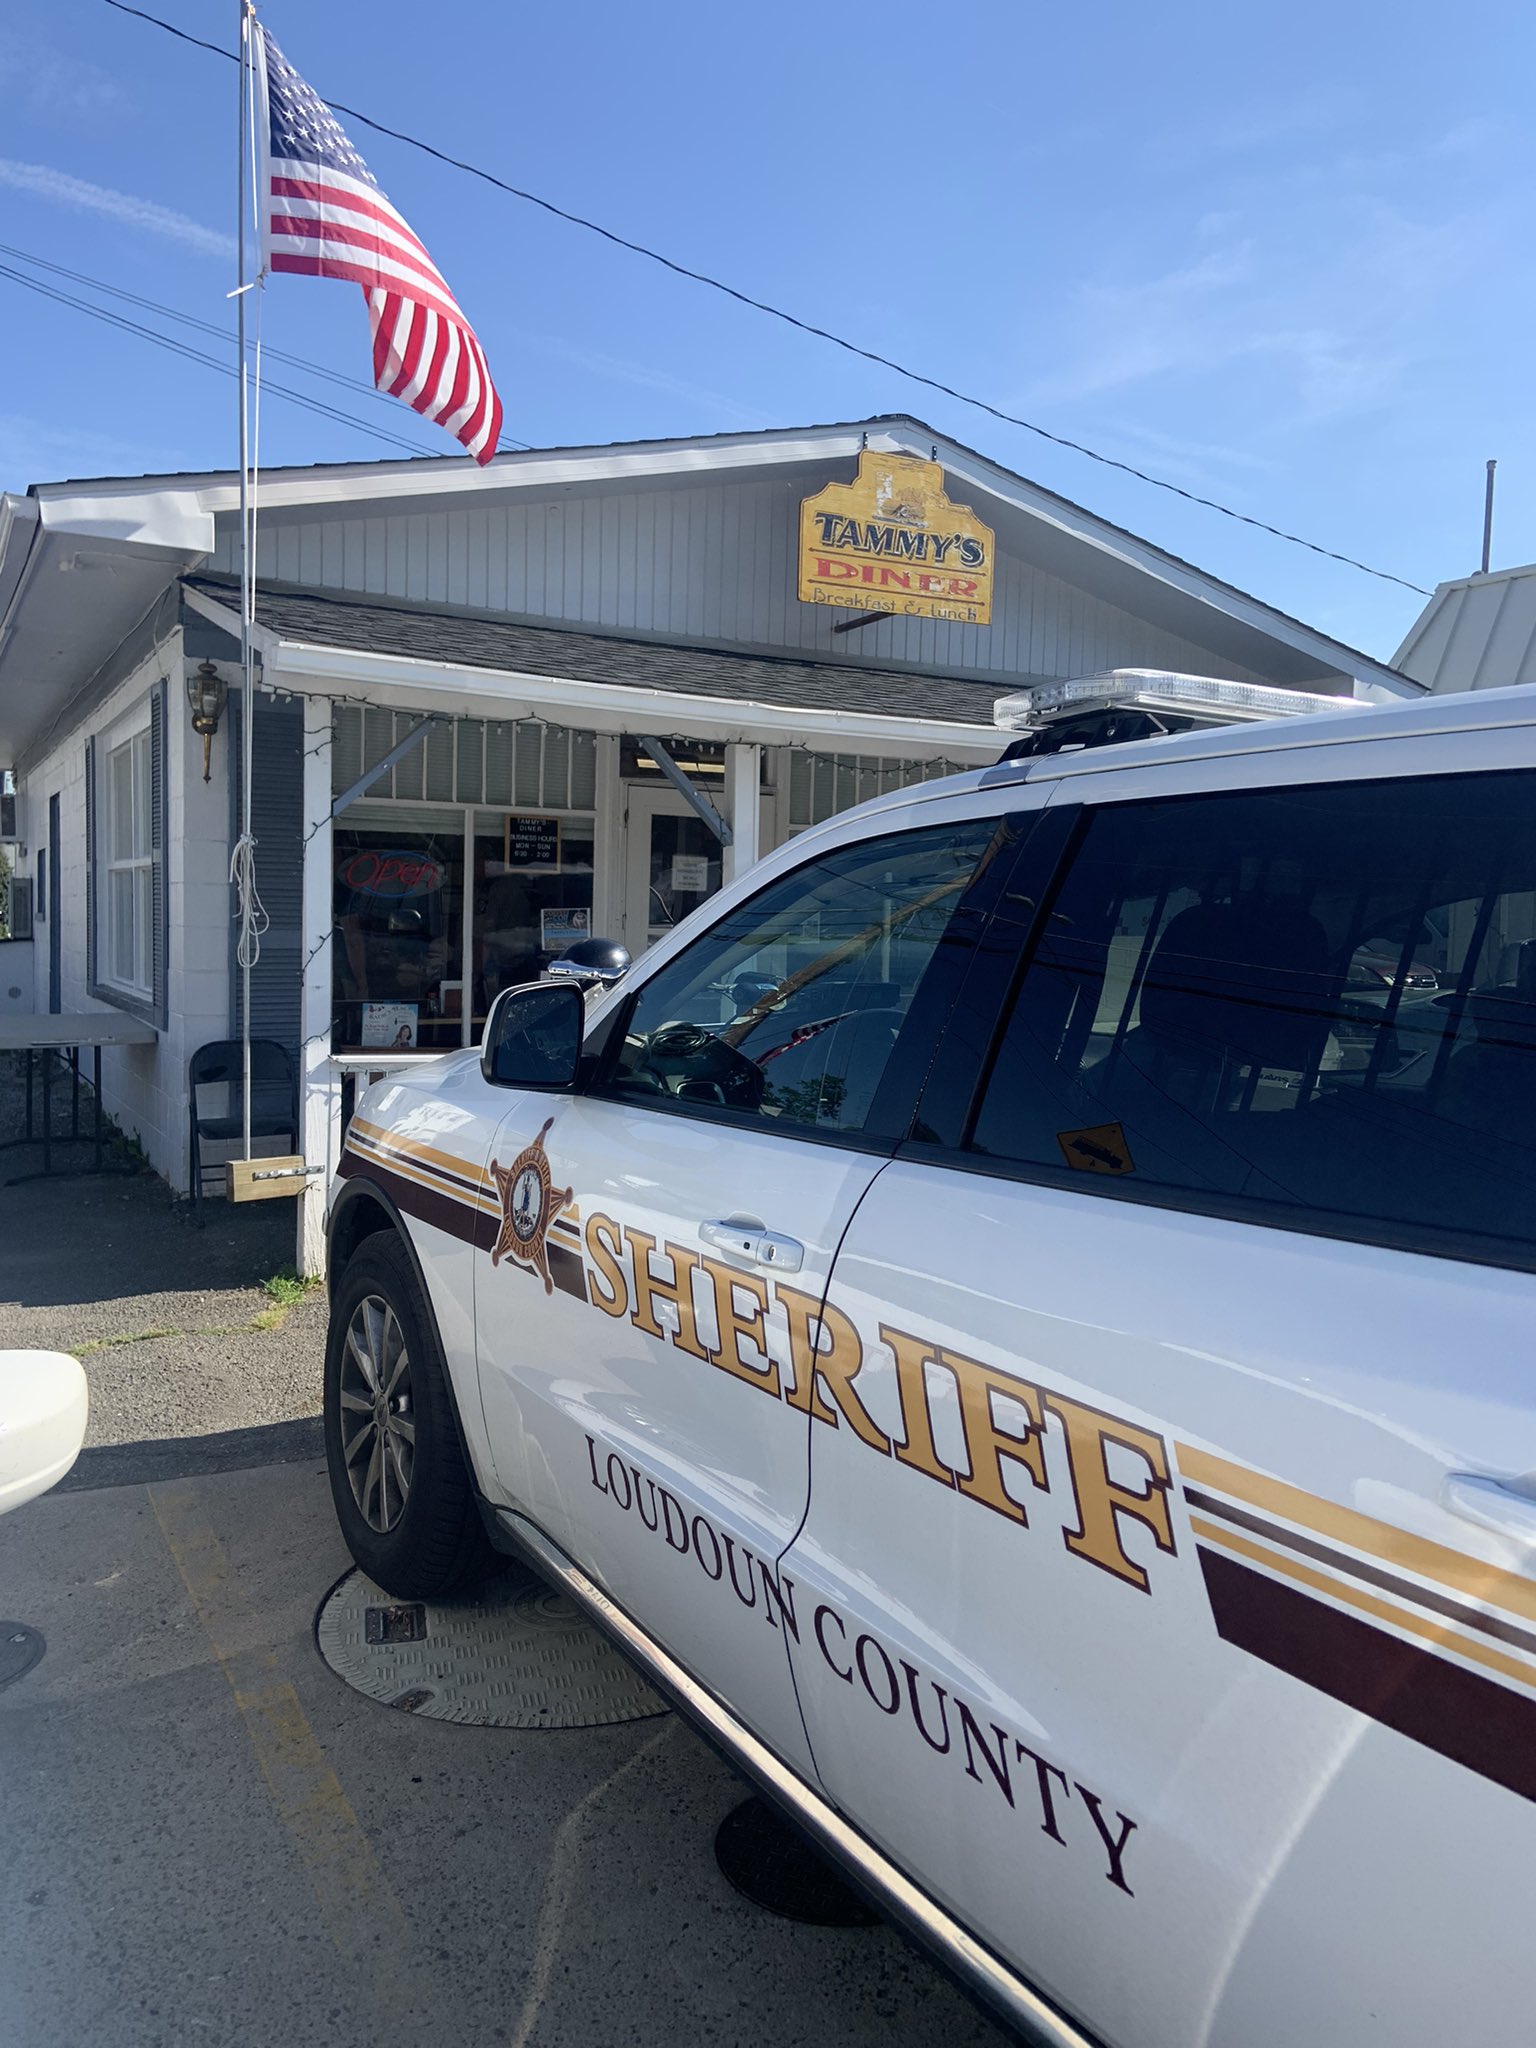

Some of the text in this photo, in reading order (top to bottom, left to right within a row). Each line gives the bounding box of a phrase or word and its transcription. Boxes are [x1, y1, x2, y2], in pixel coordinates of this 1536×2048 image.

[814, 512, 985, 568] TAMMY'S
[812, 557, 979, 598] DINER
[813, 587, 896, 610] Breakfast
[904, 600, 921, 615] &
[583, 1211, 1180, 1597] SHERIFF
[584, 1433, 1139, 1900] LOUDOUN COUNTY
